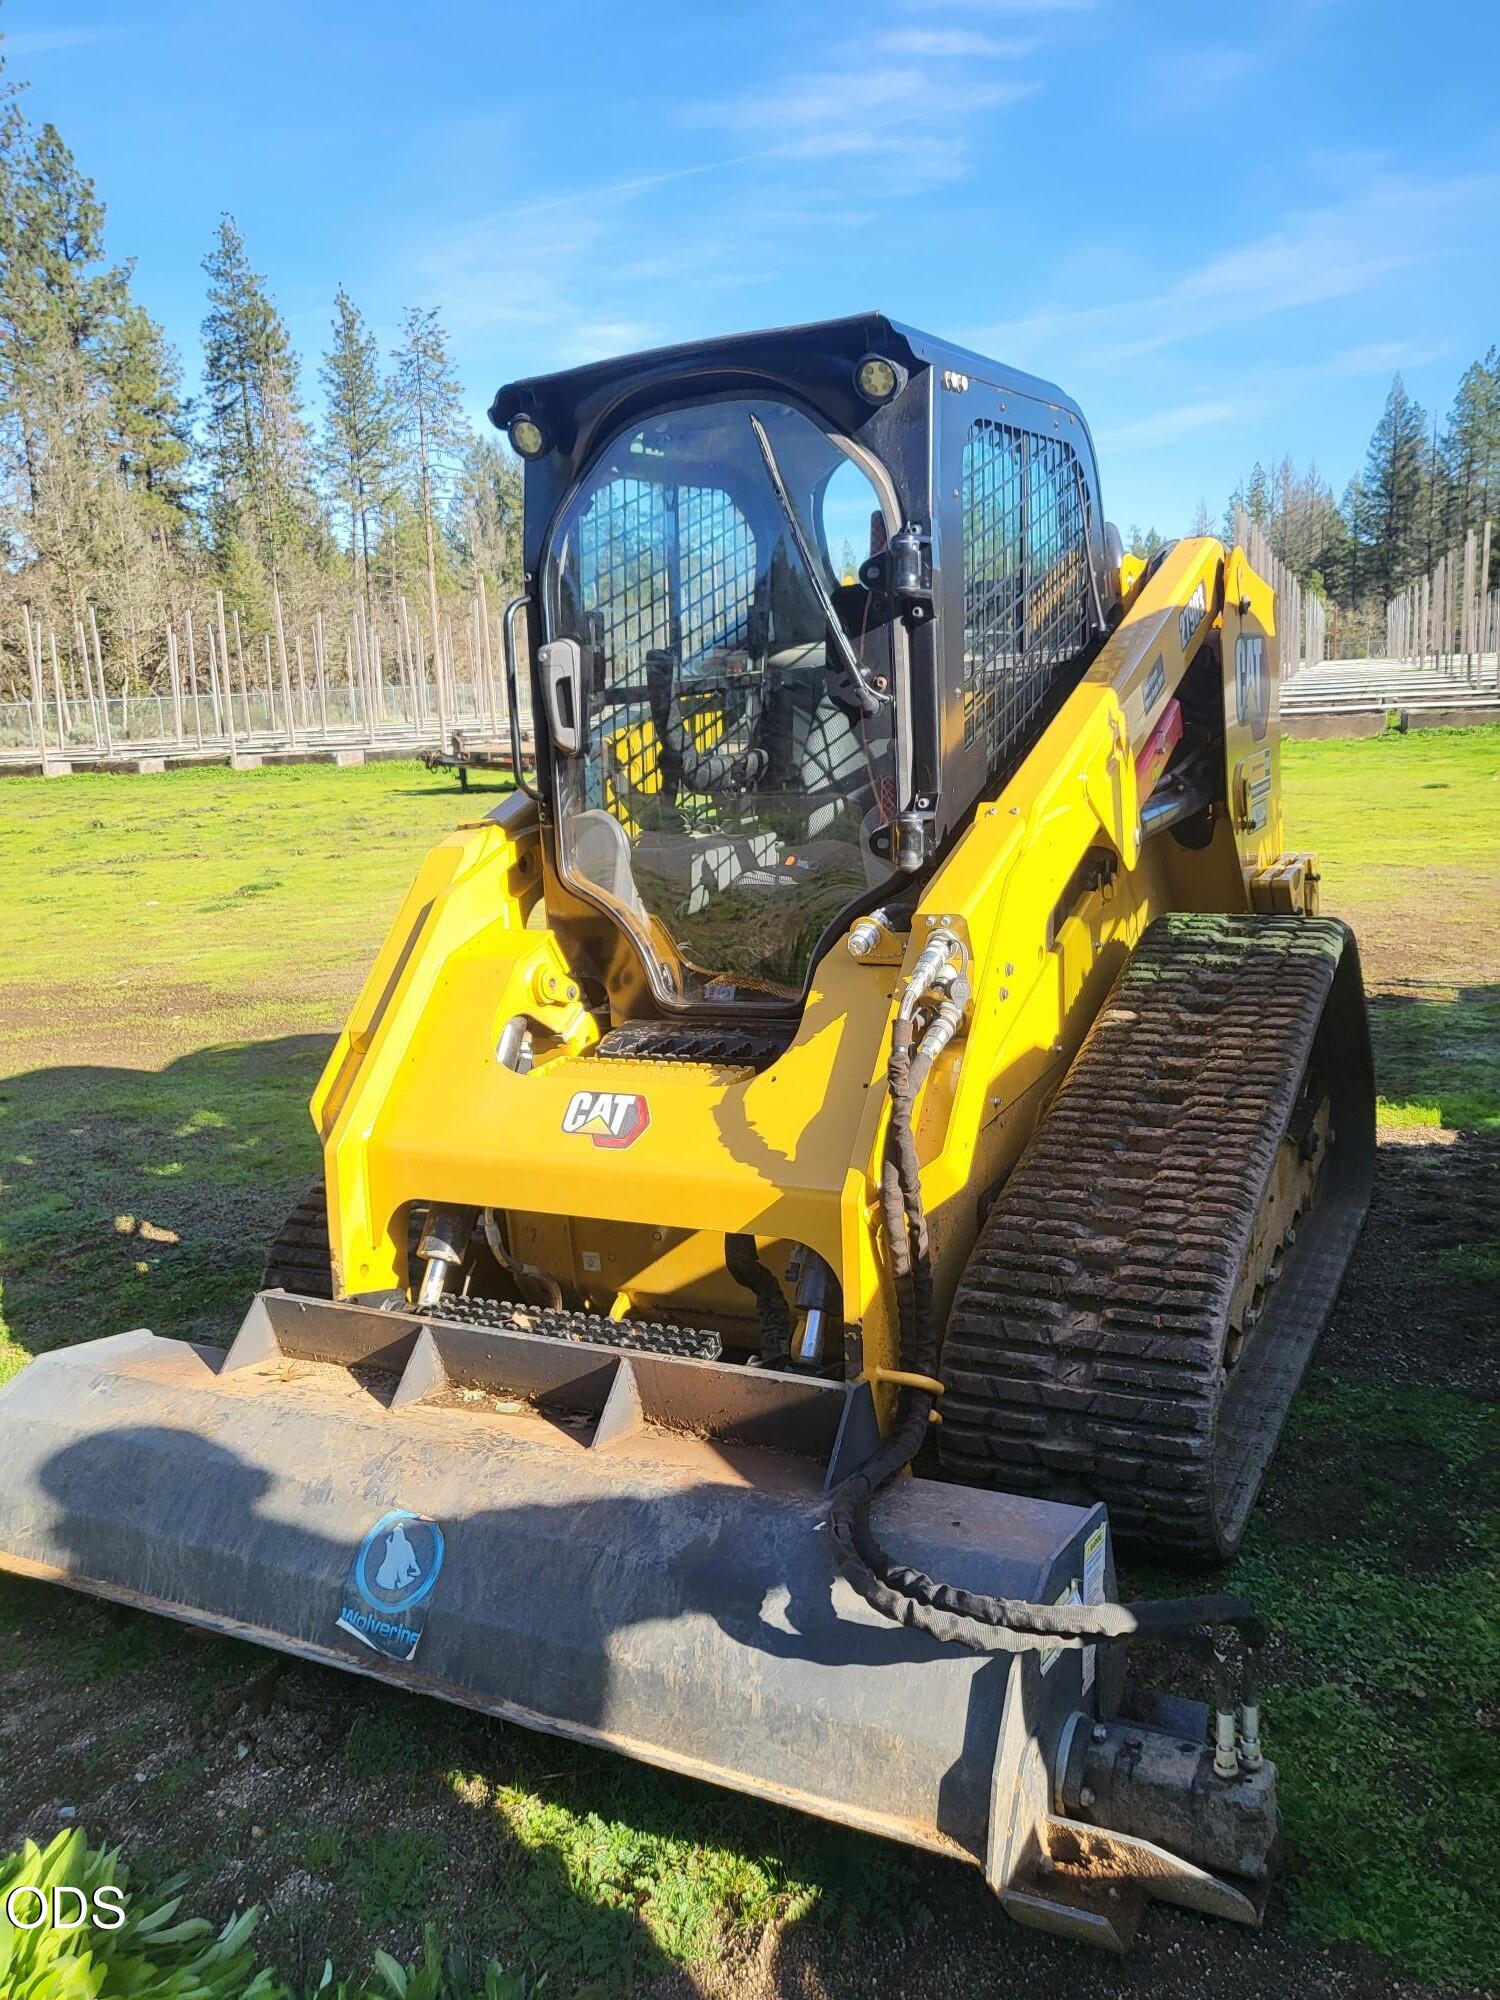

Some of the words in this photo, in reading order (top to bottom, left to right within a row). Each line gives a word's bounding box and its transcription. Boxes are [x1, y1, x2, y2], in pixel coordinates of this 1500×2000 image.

[1236, 637, 1263, 723] CAT
[563, 1092, 637, 1136] CAT
[342, 1608, 421, 1644] Wolverine
